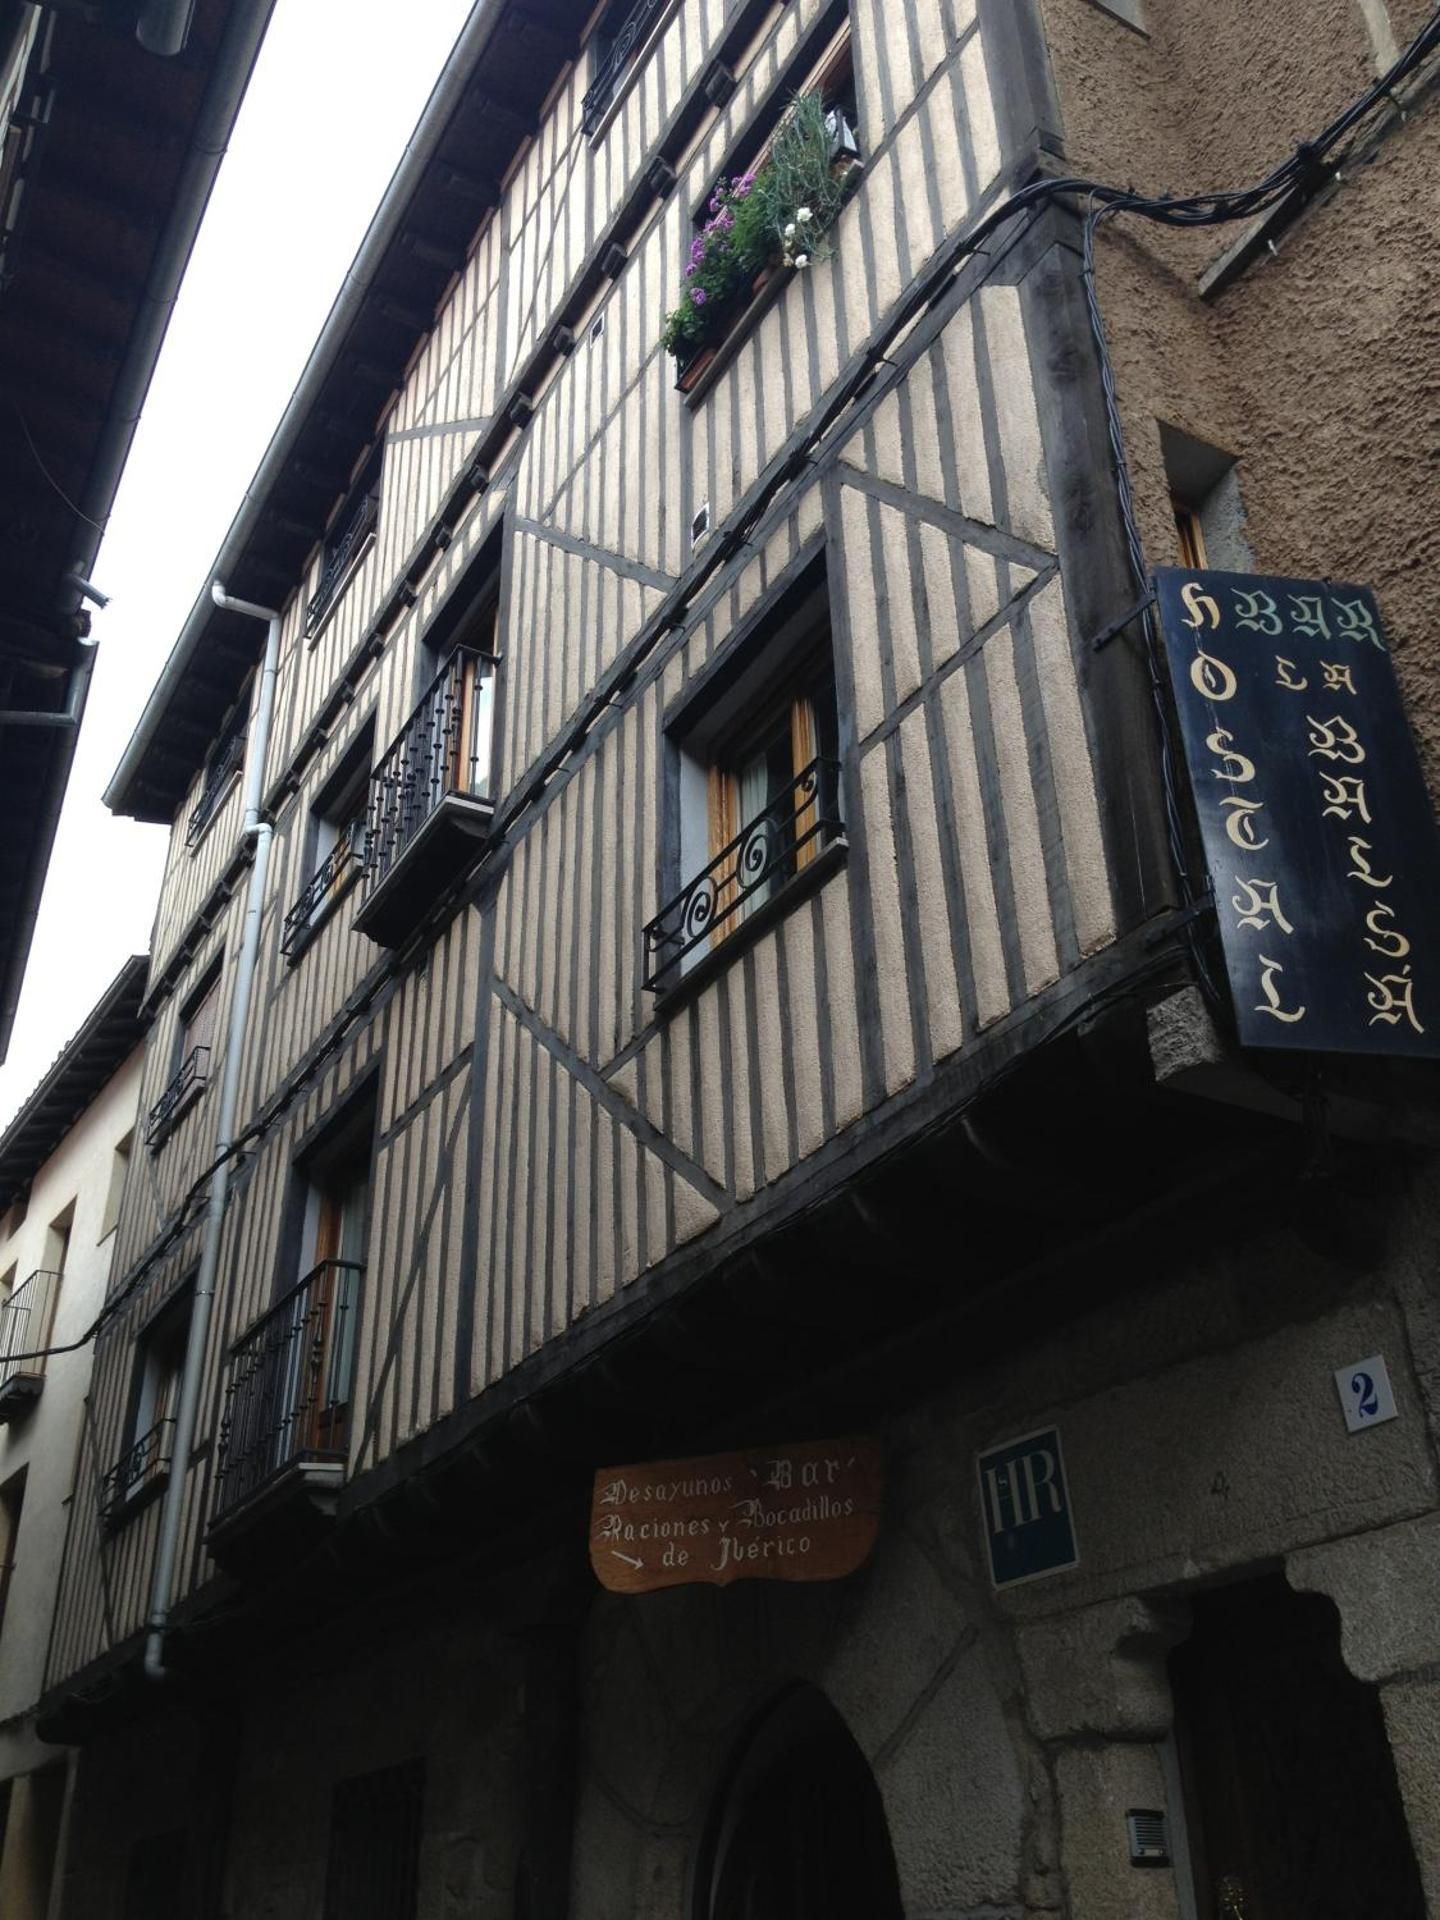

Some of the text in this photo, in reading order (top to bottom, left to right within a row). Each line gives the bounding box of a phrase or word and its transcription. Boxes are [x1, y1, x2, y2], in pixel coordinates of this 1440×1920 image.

[1230, 587, 1387, 651] BAR
[1275, 655, 1357, 695] LA
[1180, 582, 1305, 1022] HOSTAL
[1306, 713, 1424, 1034] BALSA
[1351, 1371, 1379, 1418] 2
[599, 1475, 733, 1505] Desayunos
[597, 1513, 710, 1543] Raciones
[731, 1496, 854, 1529] Bocadillos
[661, 1541, 689, 1568] de
